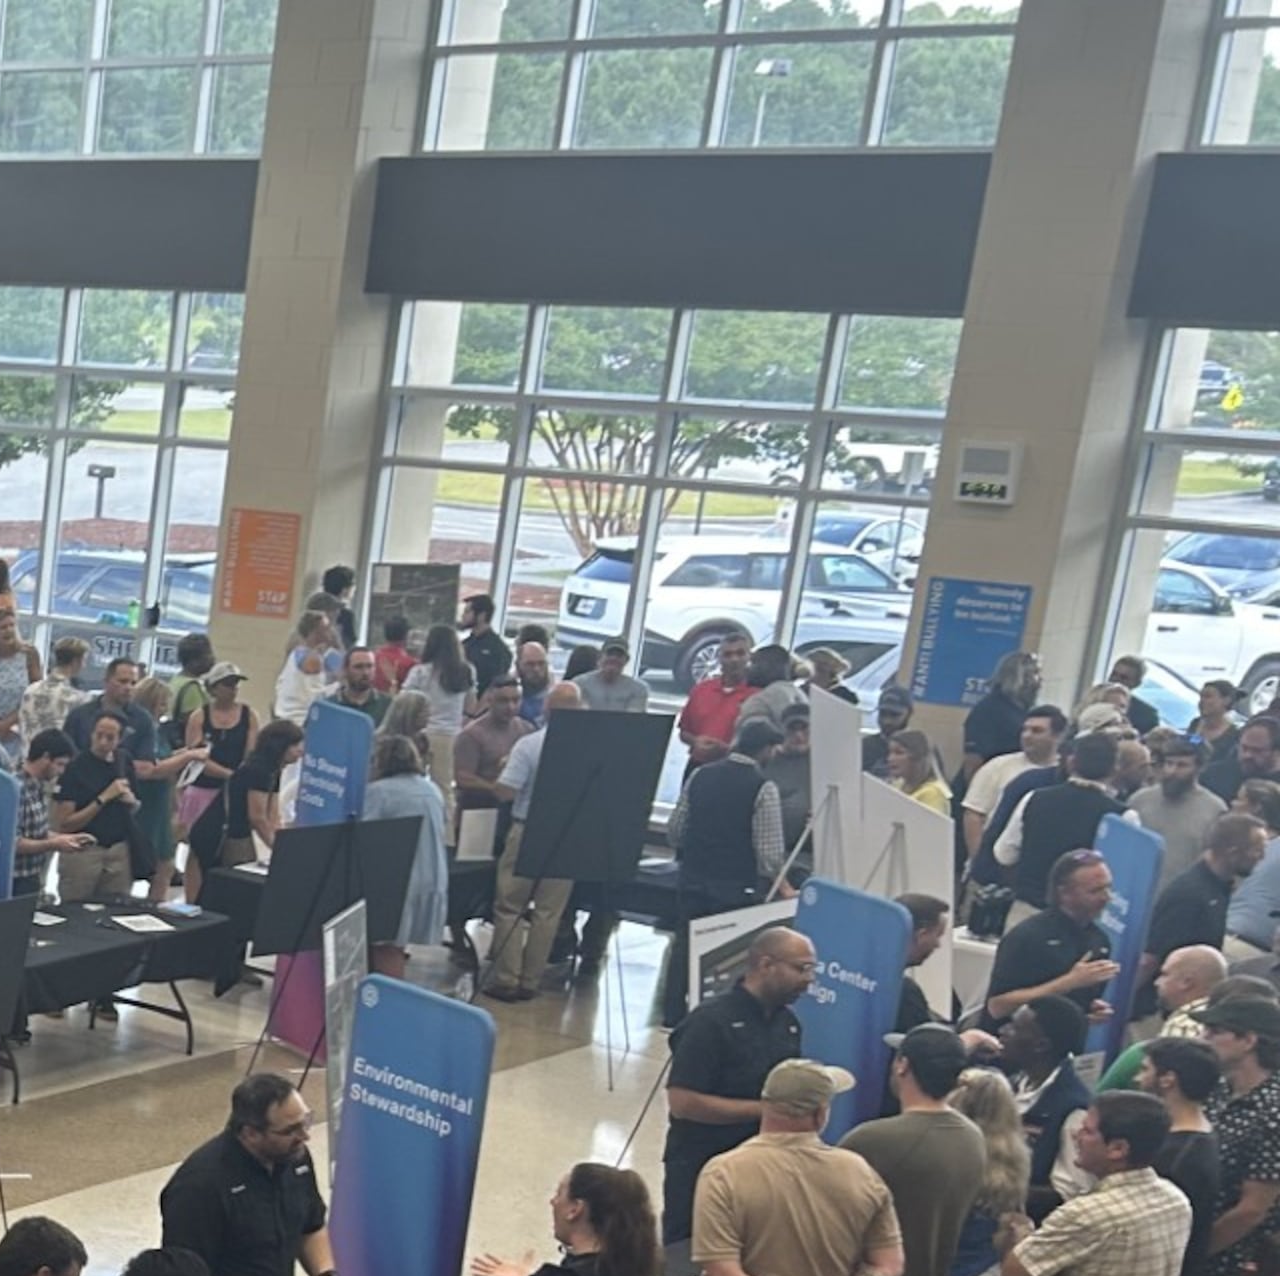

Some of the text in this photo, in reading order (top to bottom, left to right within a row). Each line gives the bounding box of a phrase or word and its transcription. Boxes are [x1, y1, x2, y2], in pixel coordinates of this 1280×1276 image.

[828, 961, 878, 993] Center
[349, 1083, 452, 1137] Stewardship
[353, 1056, 474, 1116] Environmental
